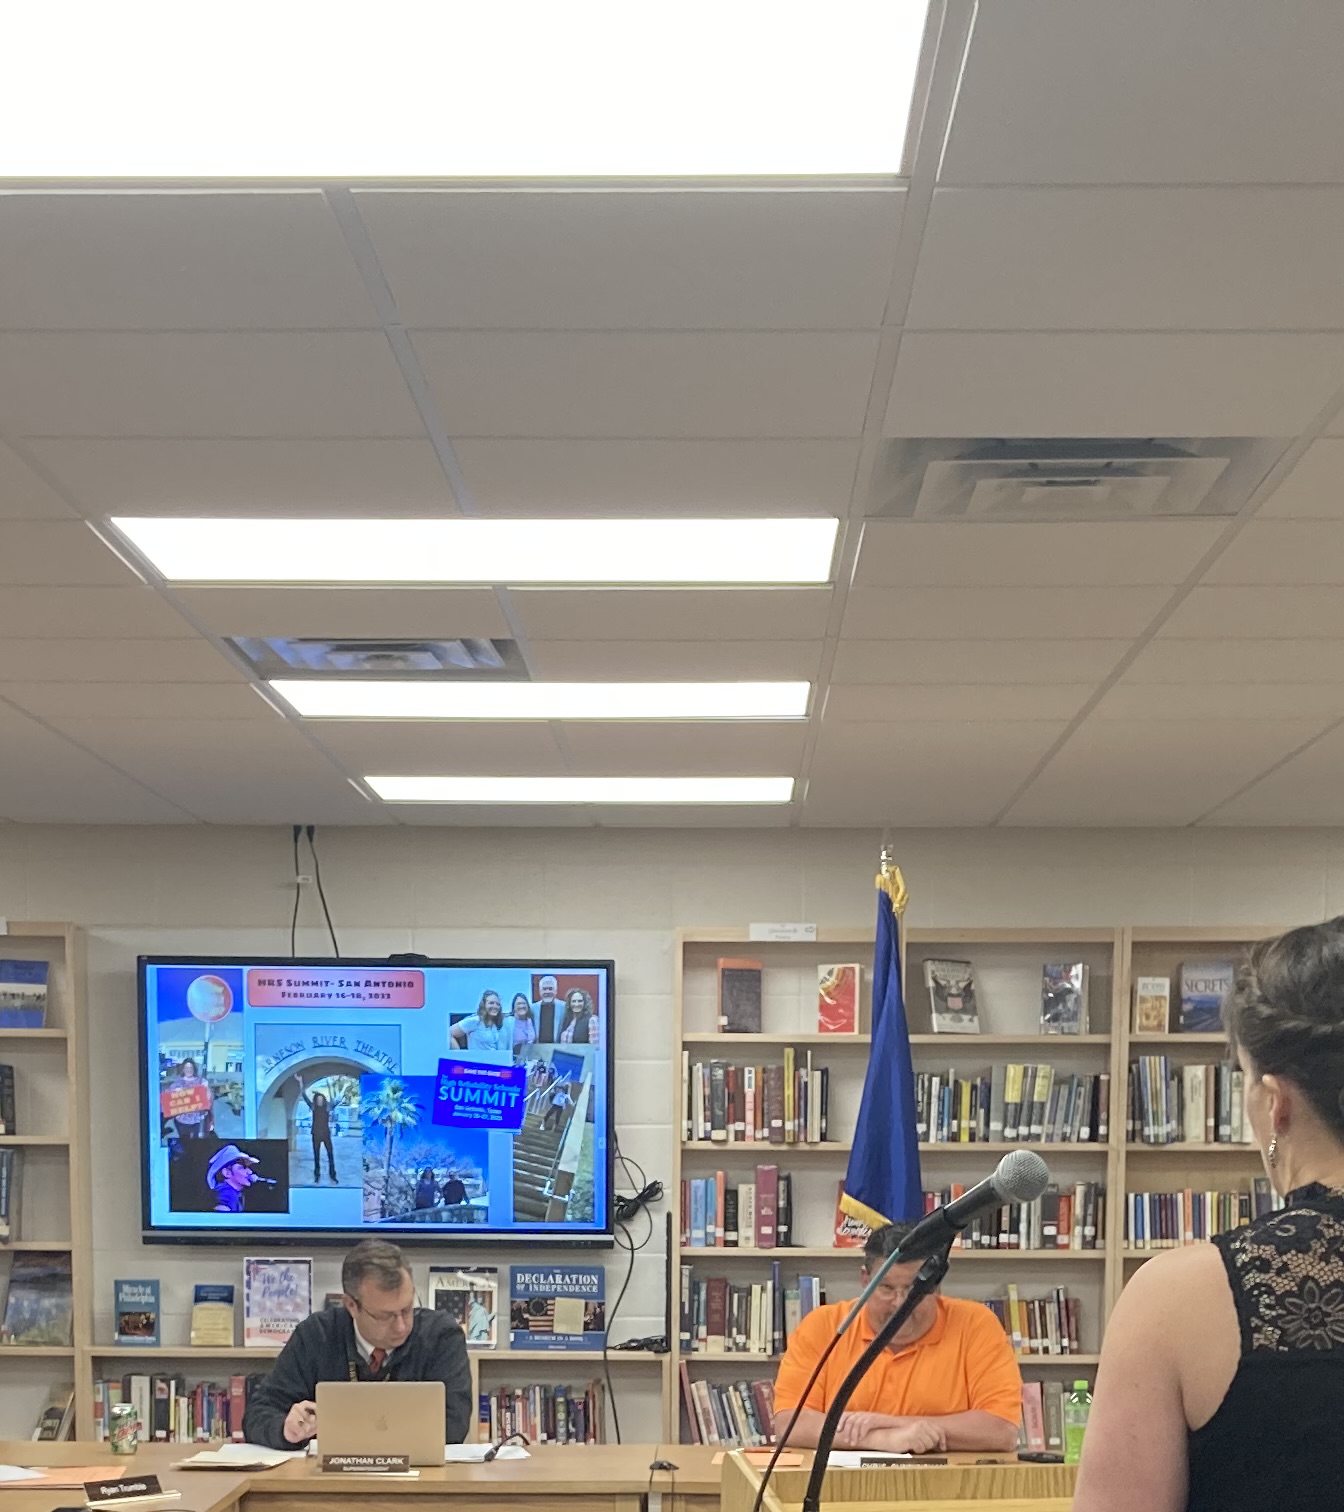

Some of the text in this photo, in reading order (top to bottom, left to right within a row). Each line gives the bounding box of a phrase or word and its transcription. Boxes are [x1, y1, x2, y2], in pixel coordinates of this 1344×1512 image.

[364, 980, 415, 988] ANTONIO
[312, 1036, 347, 1047] RIVER
[438, 1086, 520, 1108] SUMMIT
[516, 1273, 599, 1285] DECLARATION
[529, 1284, 599, 1293] INDEPENDENCE
[329, 1457, 404, 1465] JONATHAN CLARK
